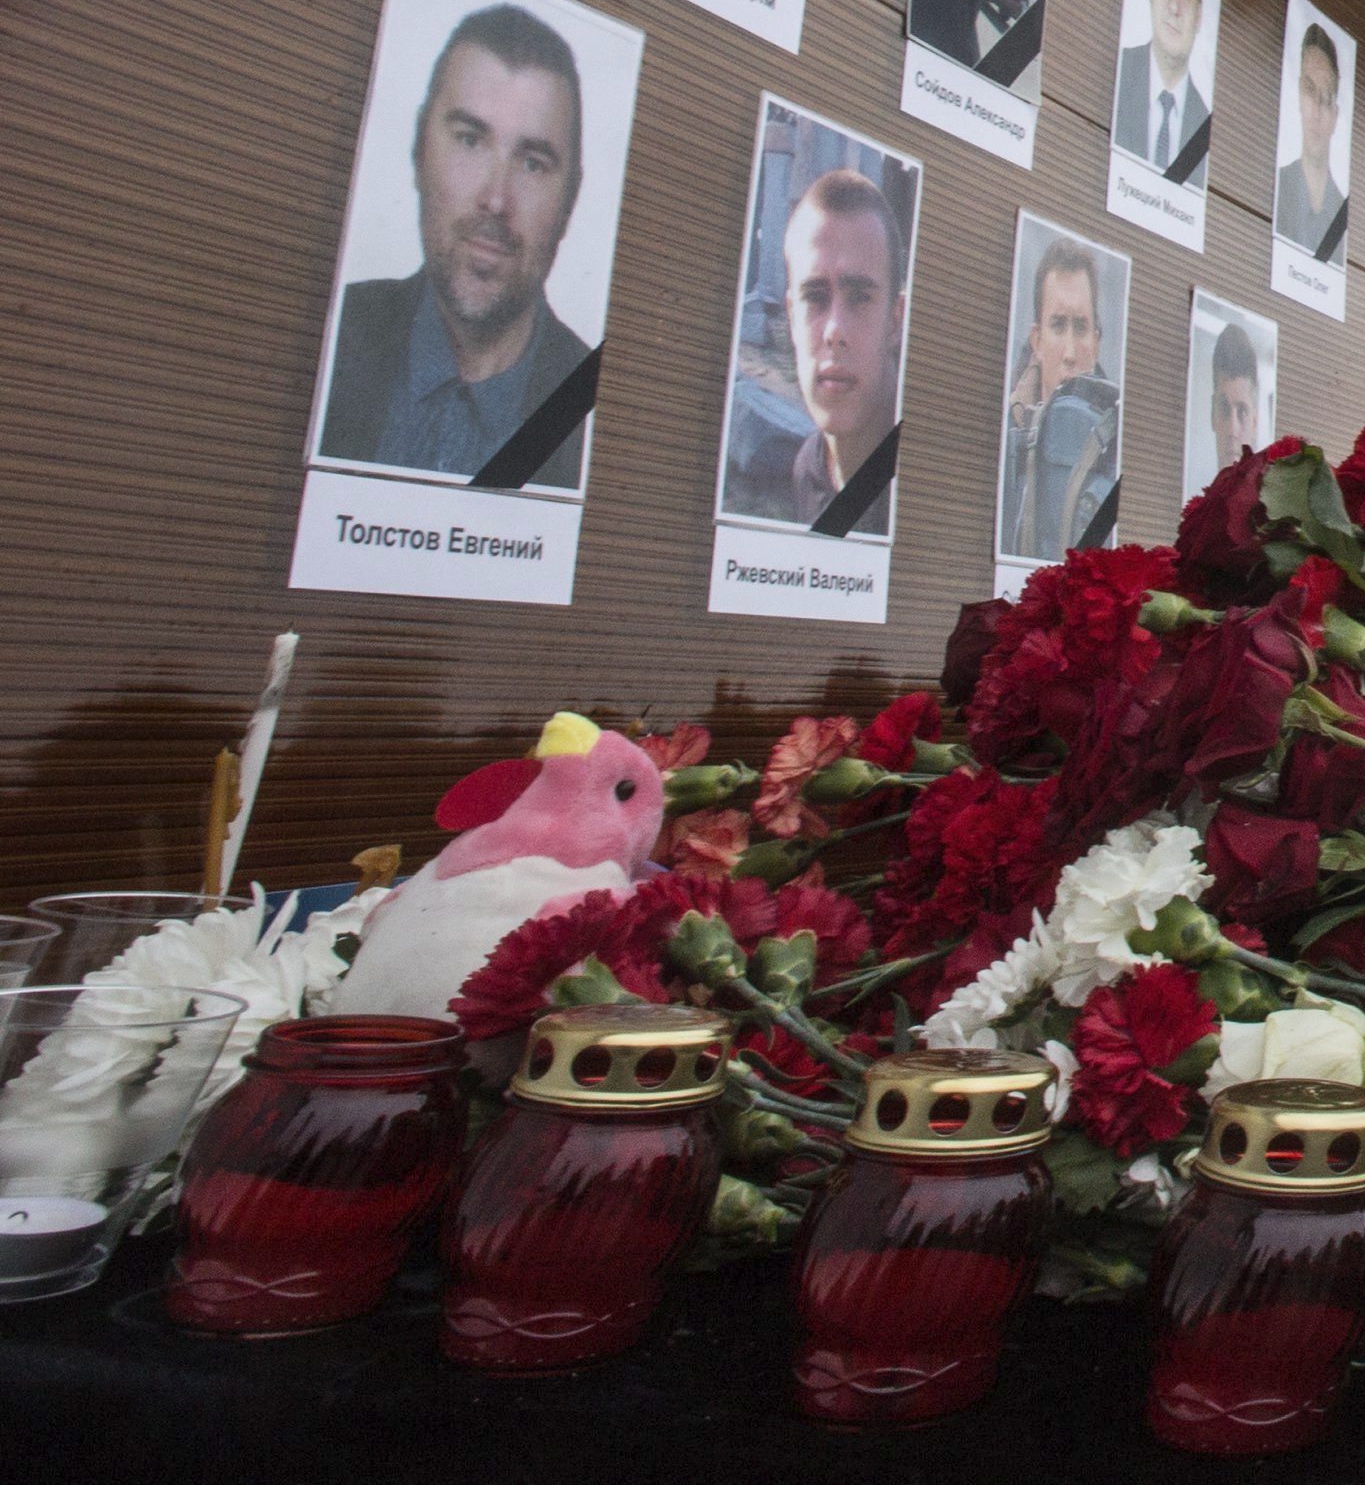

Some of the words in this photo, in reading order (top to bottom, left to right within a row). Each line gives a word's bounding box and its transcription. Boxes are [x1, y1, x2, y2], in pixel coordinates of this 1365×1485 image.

[915, 70, 961, 108] Сойдов
[964, 96, 1026, 141] Александр
[336, 514, 440, 551] Толстов
[447, 526, 544, 561] Евгений
[725, 559, 805, 588] Ржевский
[810, 568, 874, 596] Валерий
